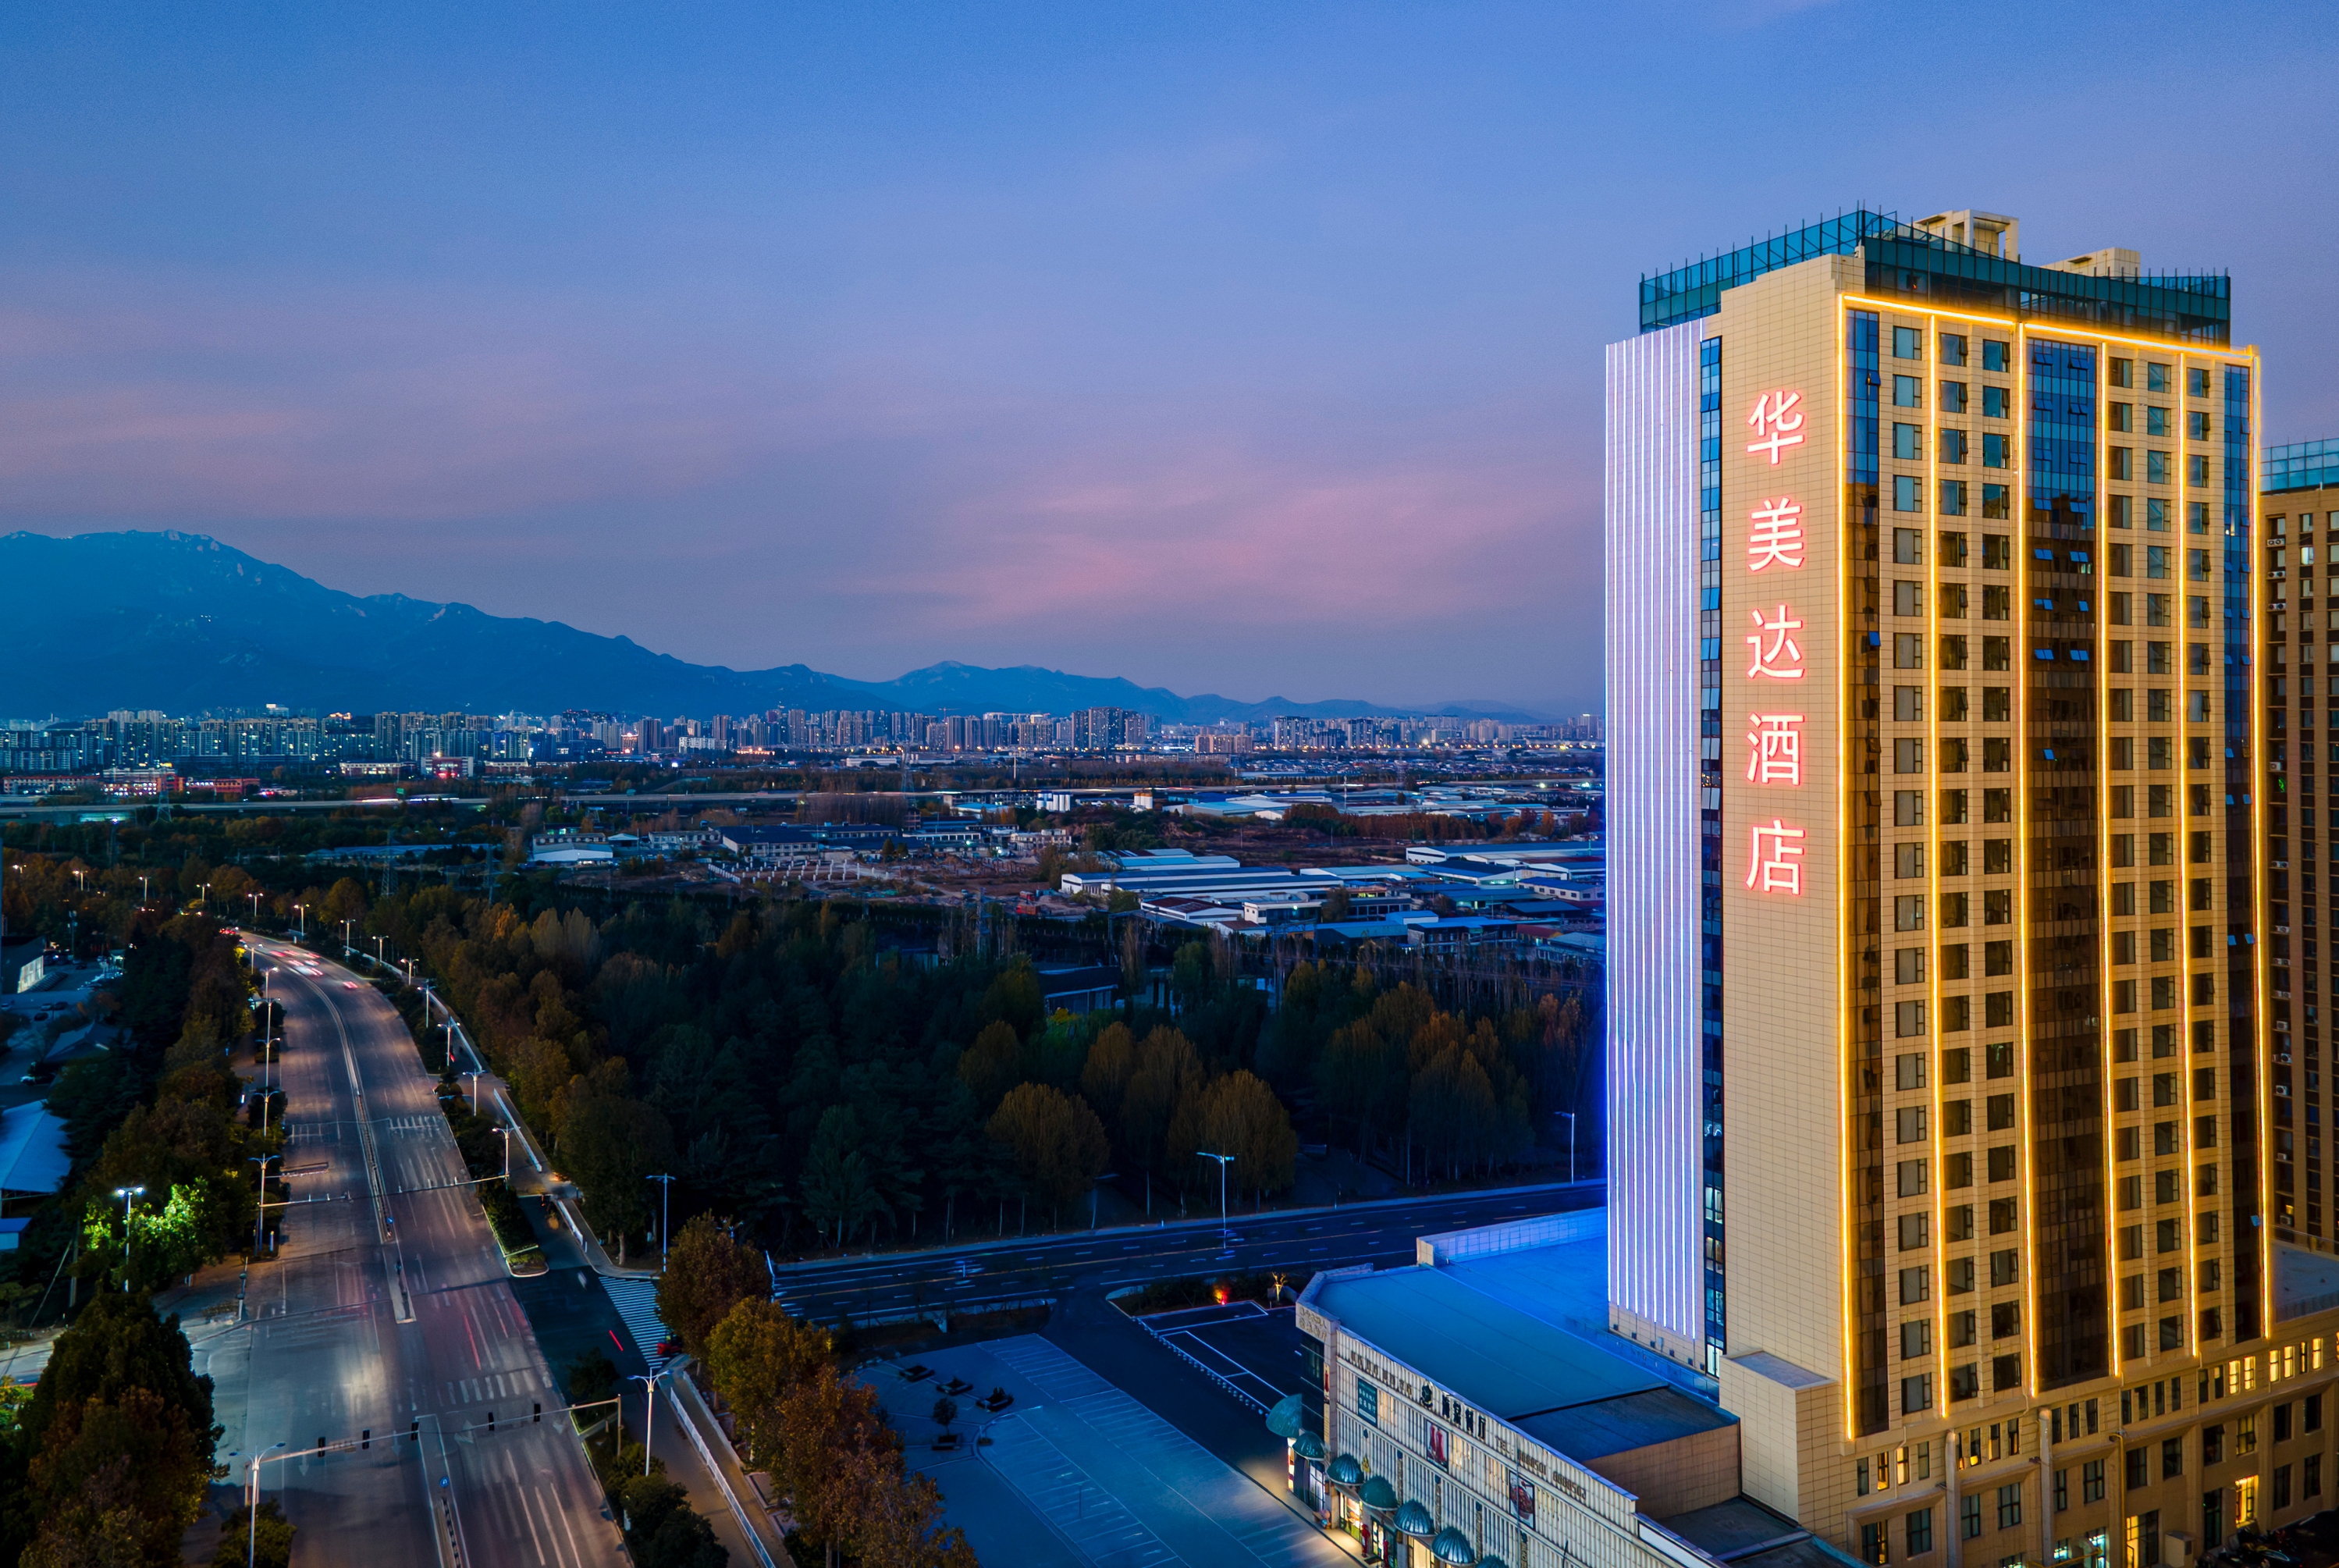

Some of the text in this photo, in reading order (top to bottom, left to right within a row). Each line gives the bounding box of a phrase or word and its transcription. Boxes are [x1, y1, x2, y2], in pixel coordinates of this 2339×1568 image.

[1747, 390, 1804, 895] 华美达酒店
